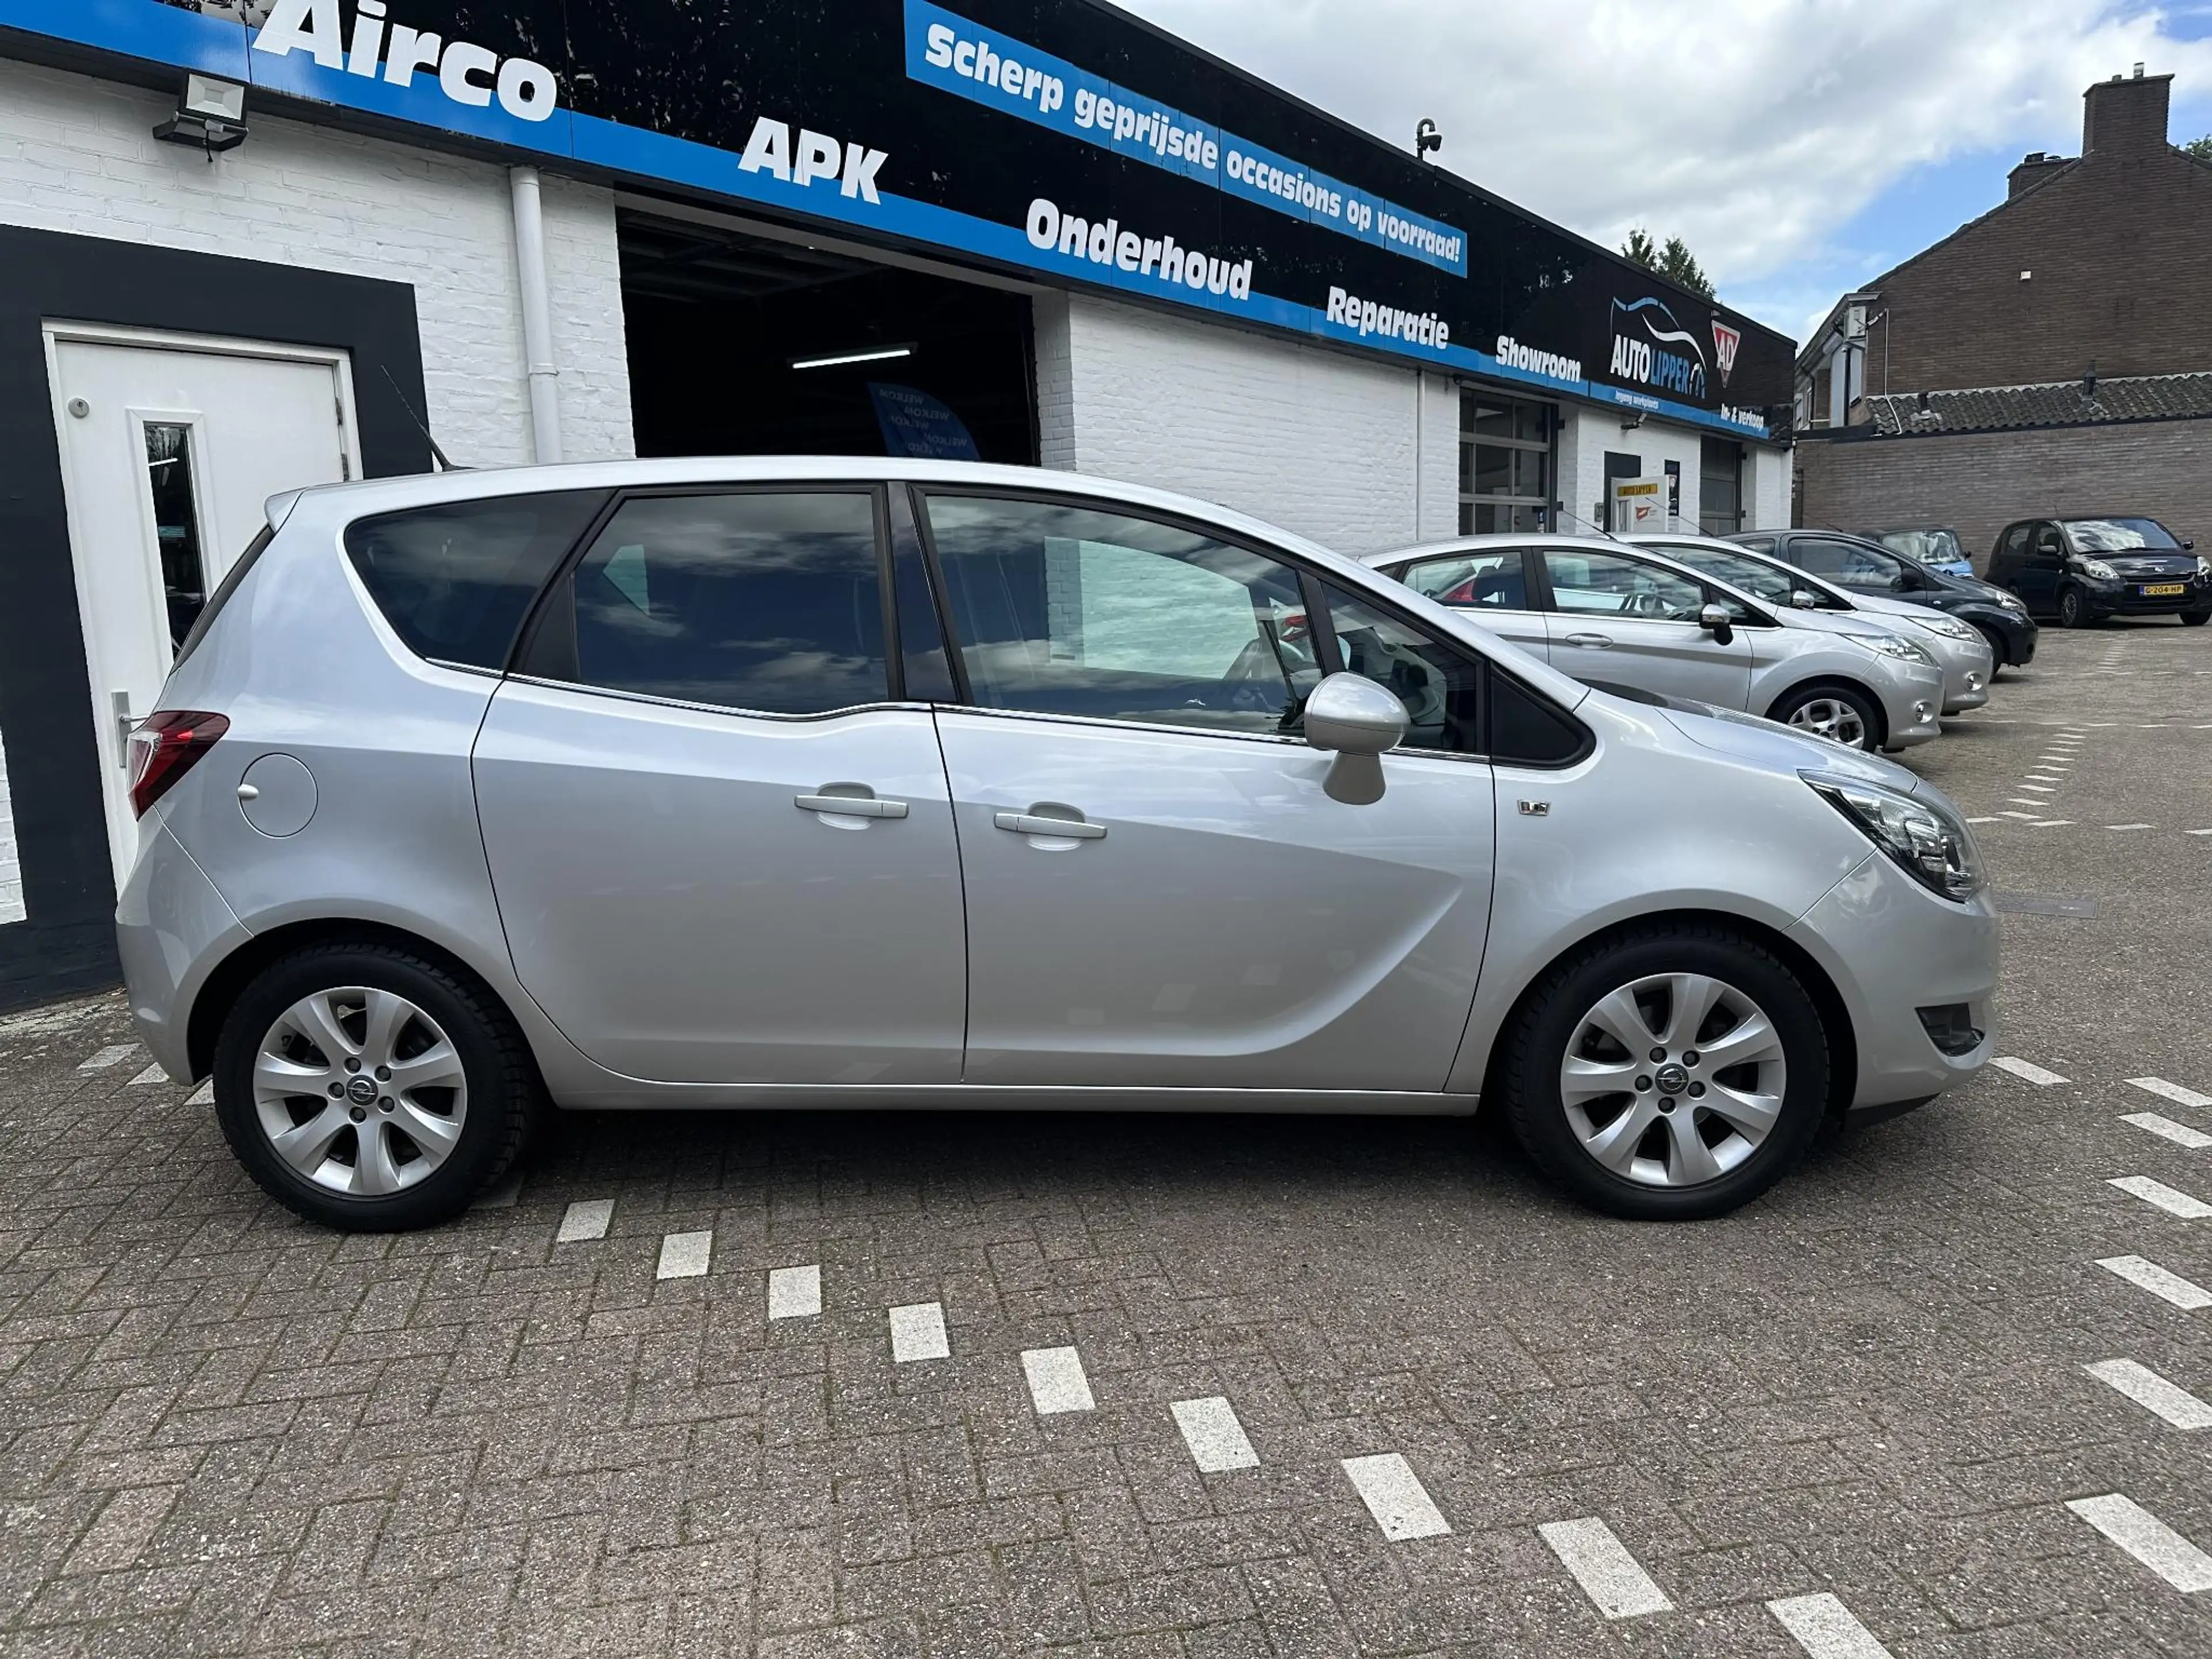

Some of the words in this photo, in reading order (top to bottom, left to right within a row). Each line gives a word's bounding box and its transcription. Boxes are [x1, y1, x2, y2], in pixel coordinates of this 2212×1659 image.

[252, 0, 556, 122] Airco
[737, 116, 889, 205] APK
[925, 24, 1064, 113] Scherp
[1074, 88, 1218, 169] geprijsde
[1226, 150, 1342, 217] occasions
[1346, 199, 1372, 232] op
[1377, 211, 1461, 262] voorraad!
[1027, 198, 1253, 300] Onderhoud
[1326, 286, 1449, 350] Reparatie
[1496, 335, 1581, 383] Showroom
[1716, 332, 1734, 372] AD
